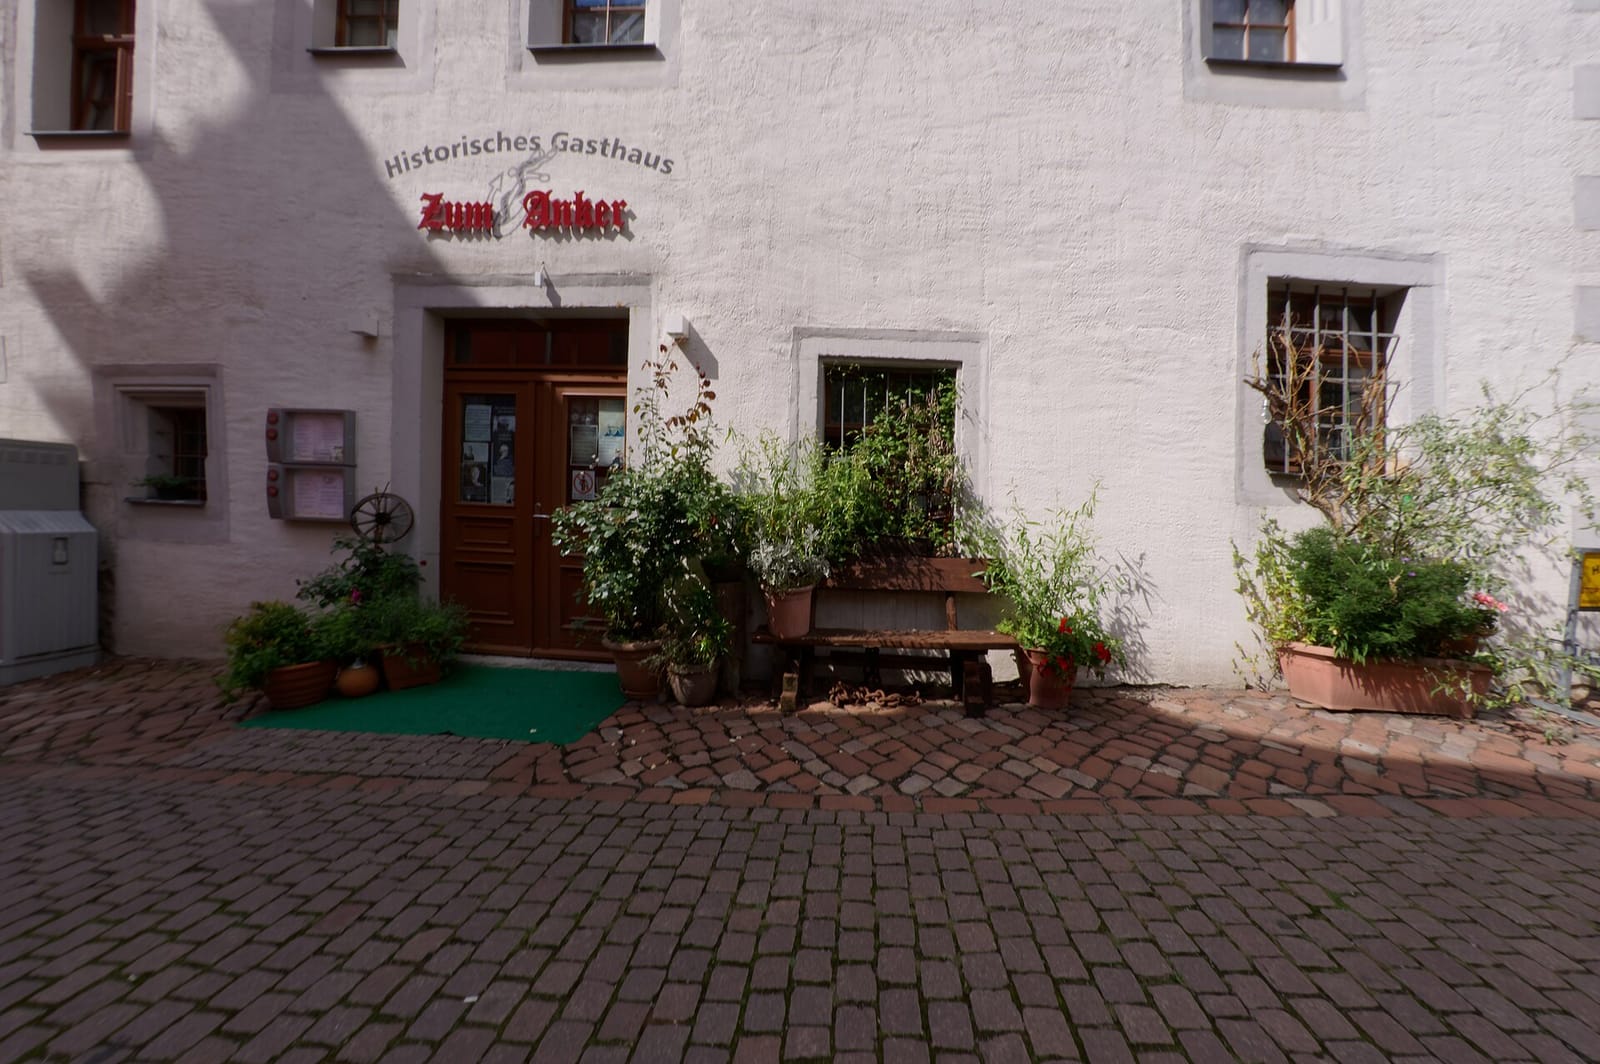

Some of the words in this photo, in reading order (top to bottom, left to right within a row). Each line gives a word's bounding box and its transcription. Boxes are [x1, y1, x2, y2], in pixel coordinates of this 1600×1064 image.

[384, 131, 541, 178] Historisches
[551, 132, 675, 175] Gasthaus
[417, 192, 493, 230] Zum
[522, 190, 627, 230] Anker
